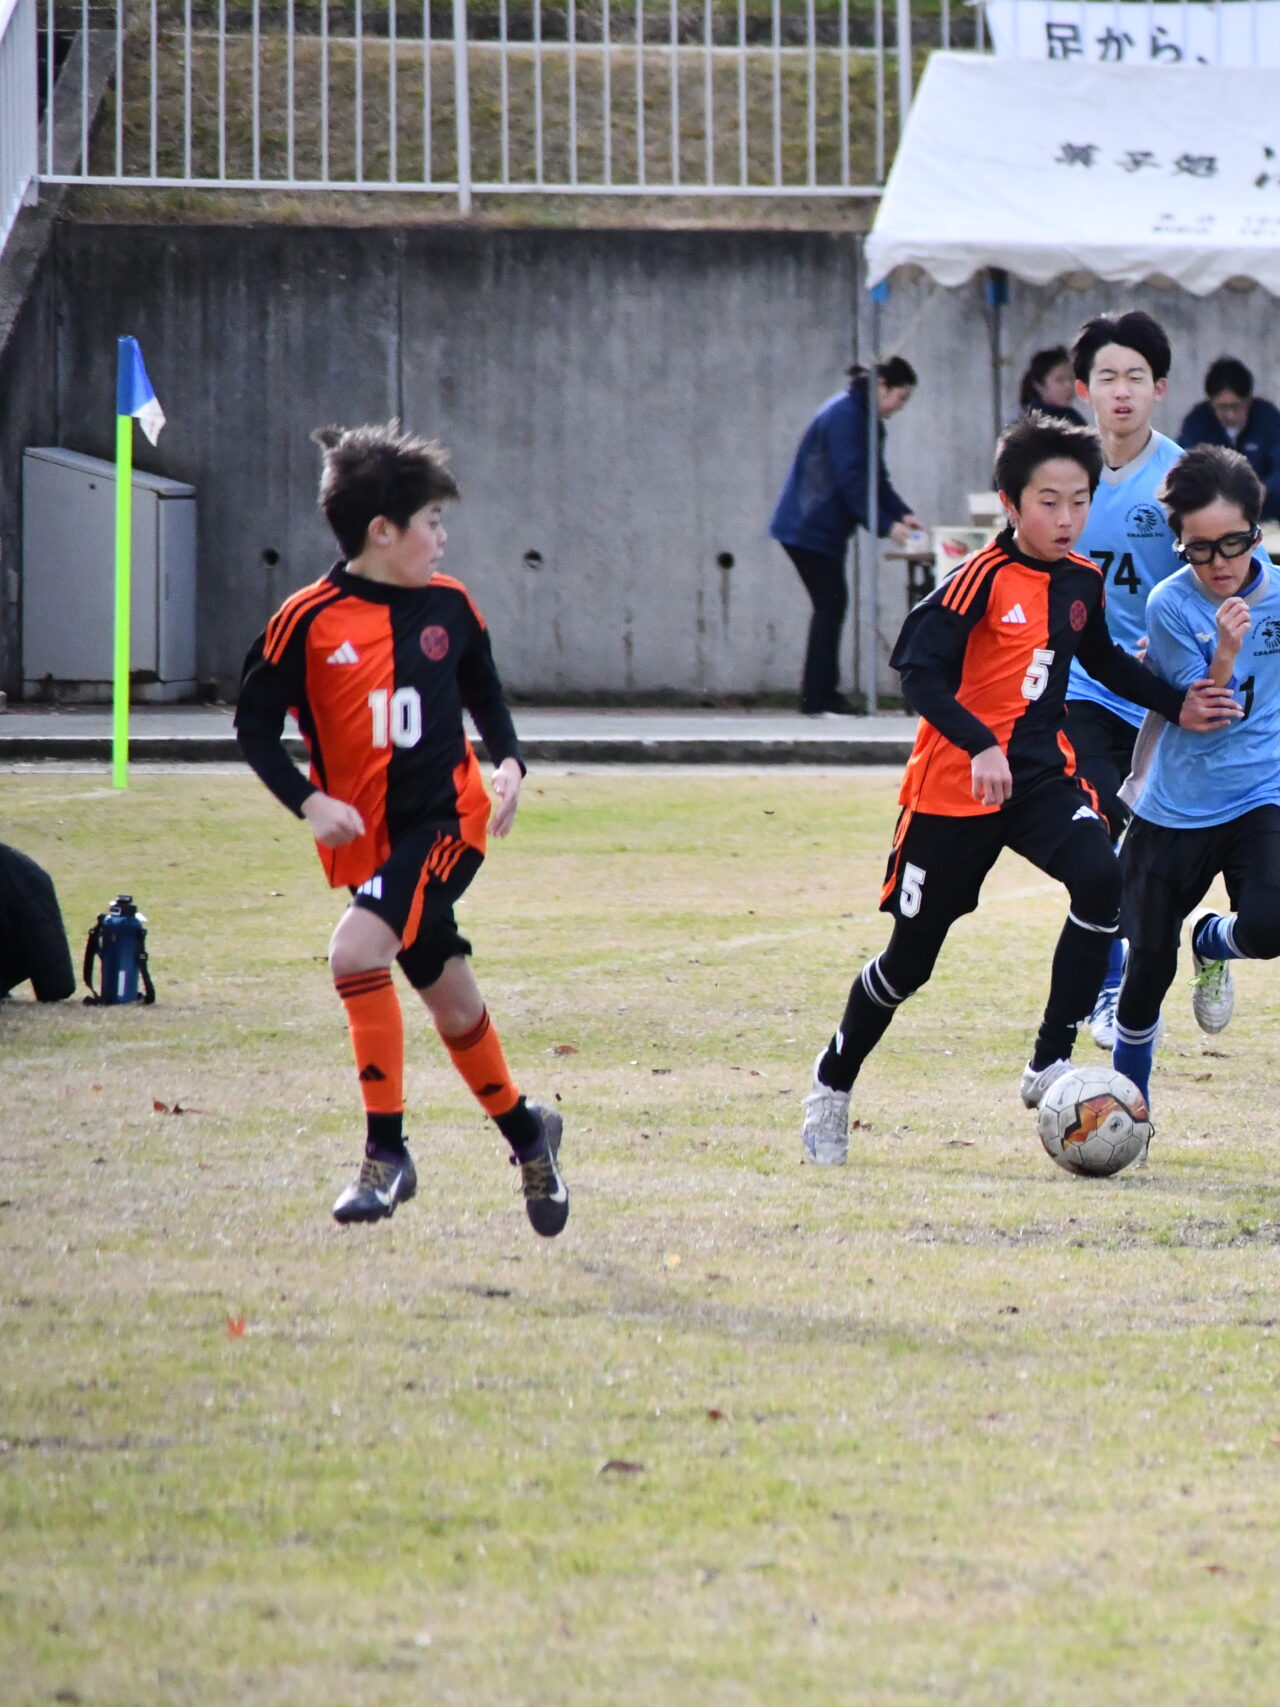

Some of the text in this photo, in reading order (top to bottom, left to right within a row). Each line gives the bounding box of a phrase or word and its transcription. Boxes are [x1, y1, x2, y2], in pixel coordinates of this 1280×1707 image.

[1089, 550, 1141, 595] 74
[1021, 648, 1055, 701] 5
[367, 686, 422, 749] 10
[900, 861, 927, 919] 5
